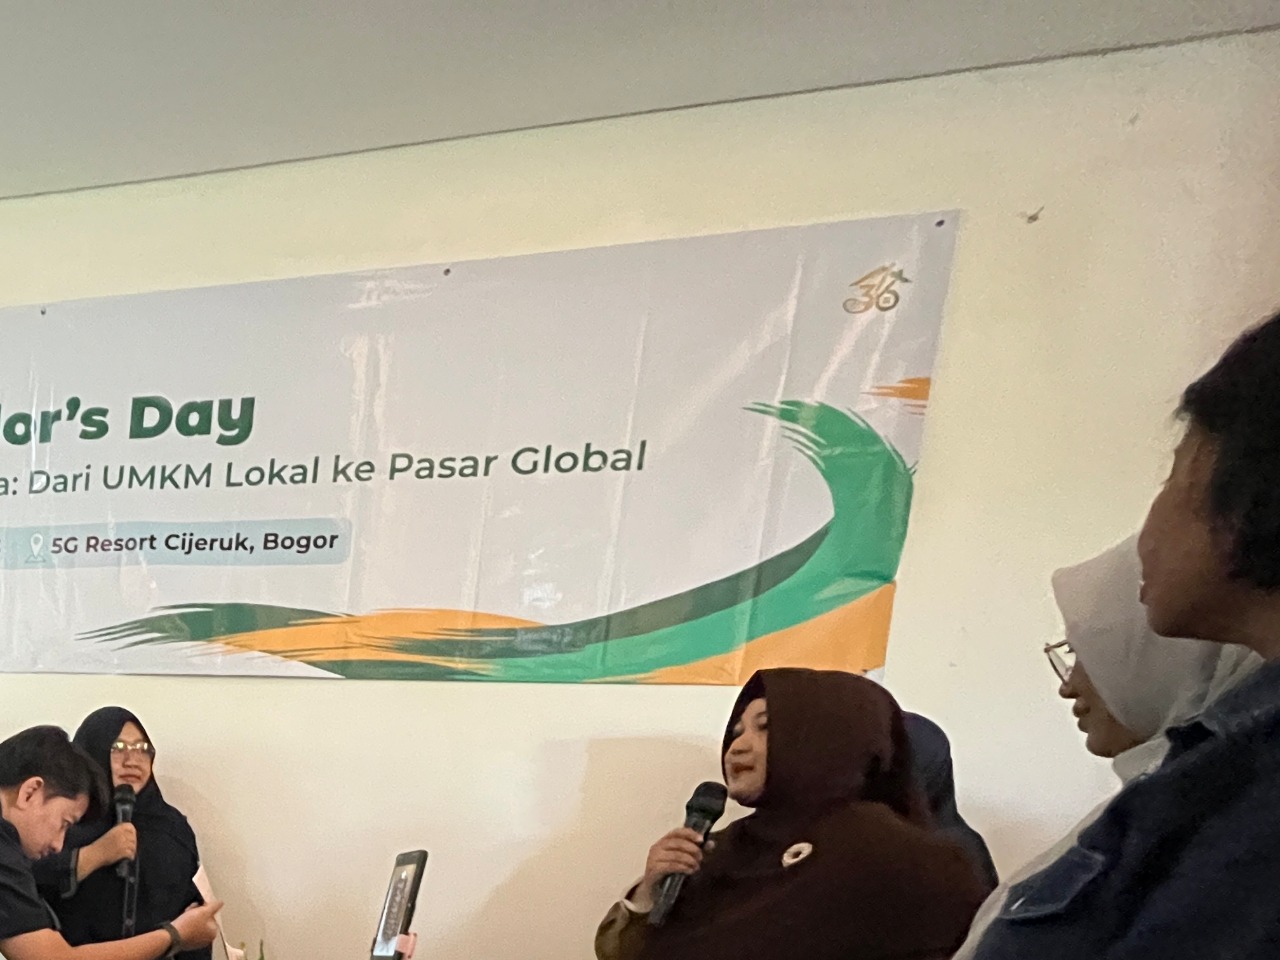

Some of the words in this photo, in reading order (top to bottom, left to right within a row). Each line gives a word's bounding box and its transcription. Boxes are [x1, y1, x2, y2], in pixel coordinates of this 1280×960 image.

[129, 395, 256, 447] Day
[28, 463, 92, 495] Dari
[102, 462, 213, 491] UMKM
[225, 455, 320, 488] Lokal
[331, 454, 376, 484] ke
[388, 452, 499, 481] Pasar
[510, 439, 648, 476] Global
[50, 536, 79, 555] 5G
[85, 533, 158, 554] Resort
[163, 531, 255, 556] Cijeruk,
[262, 532, 340, 555] Bogor
